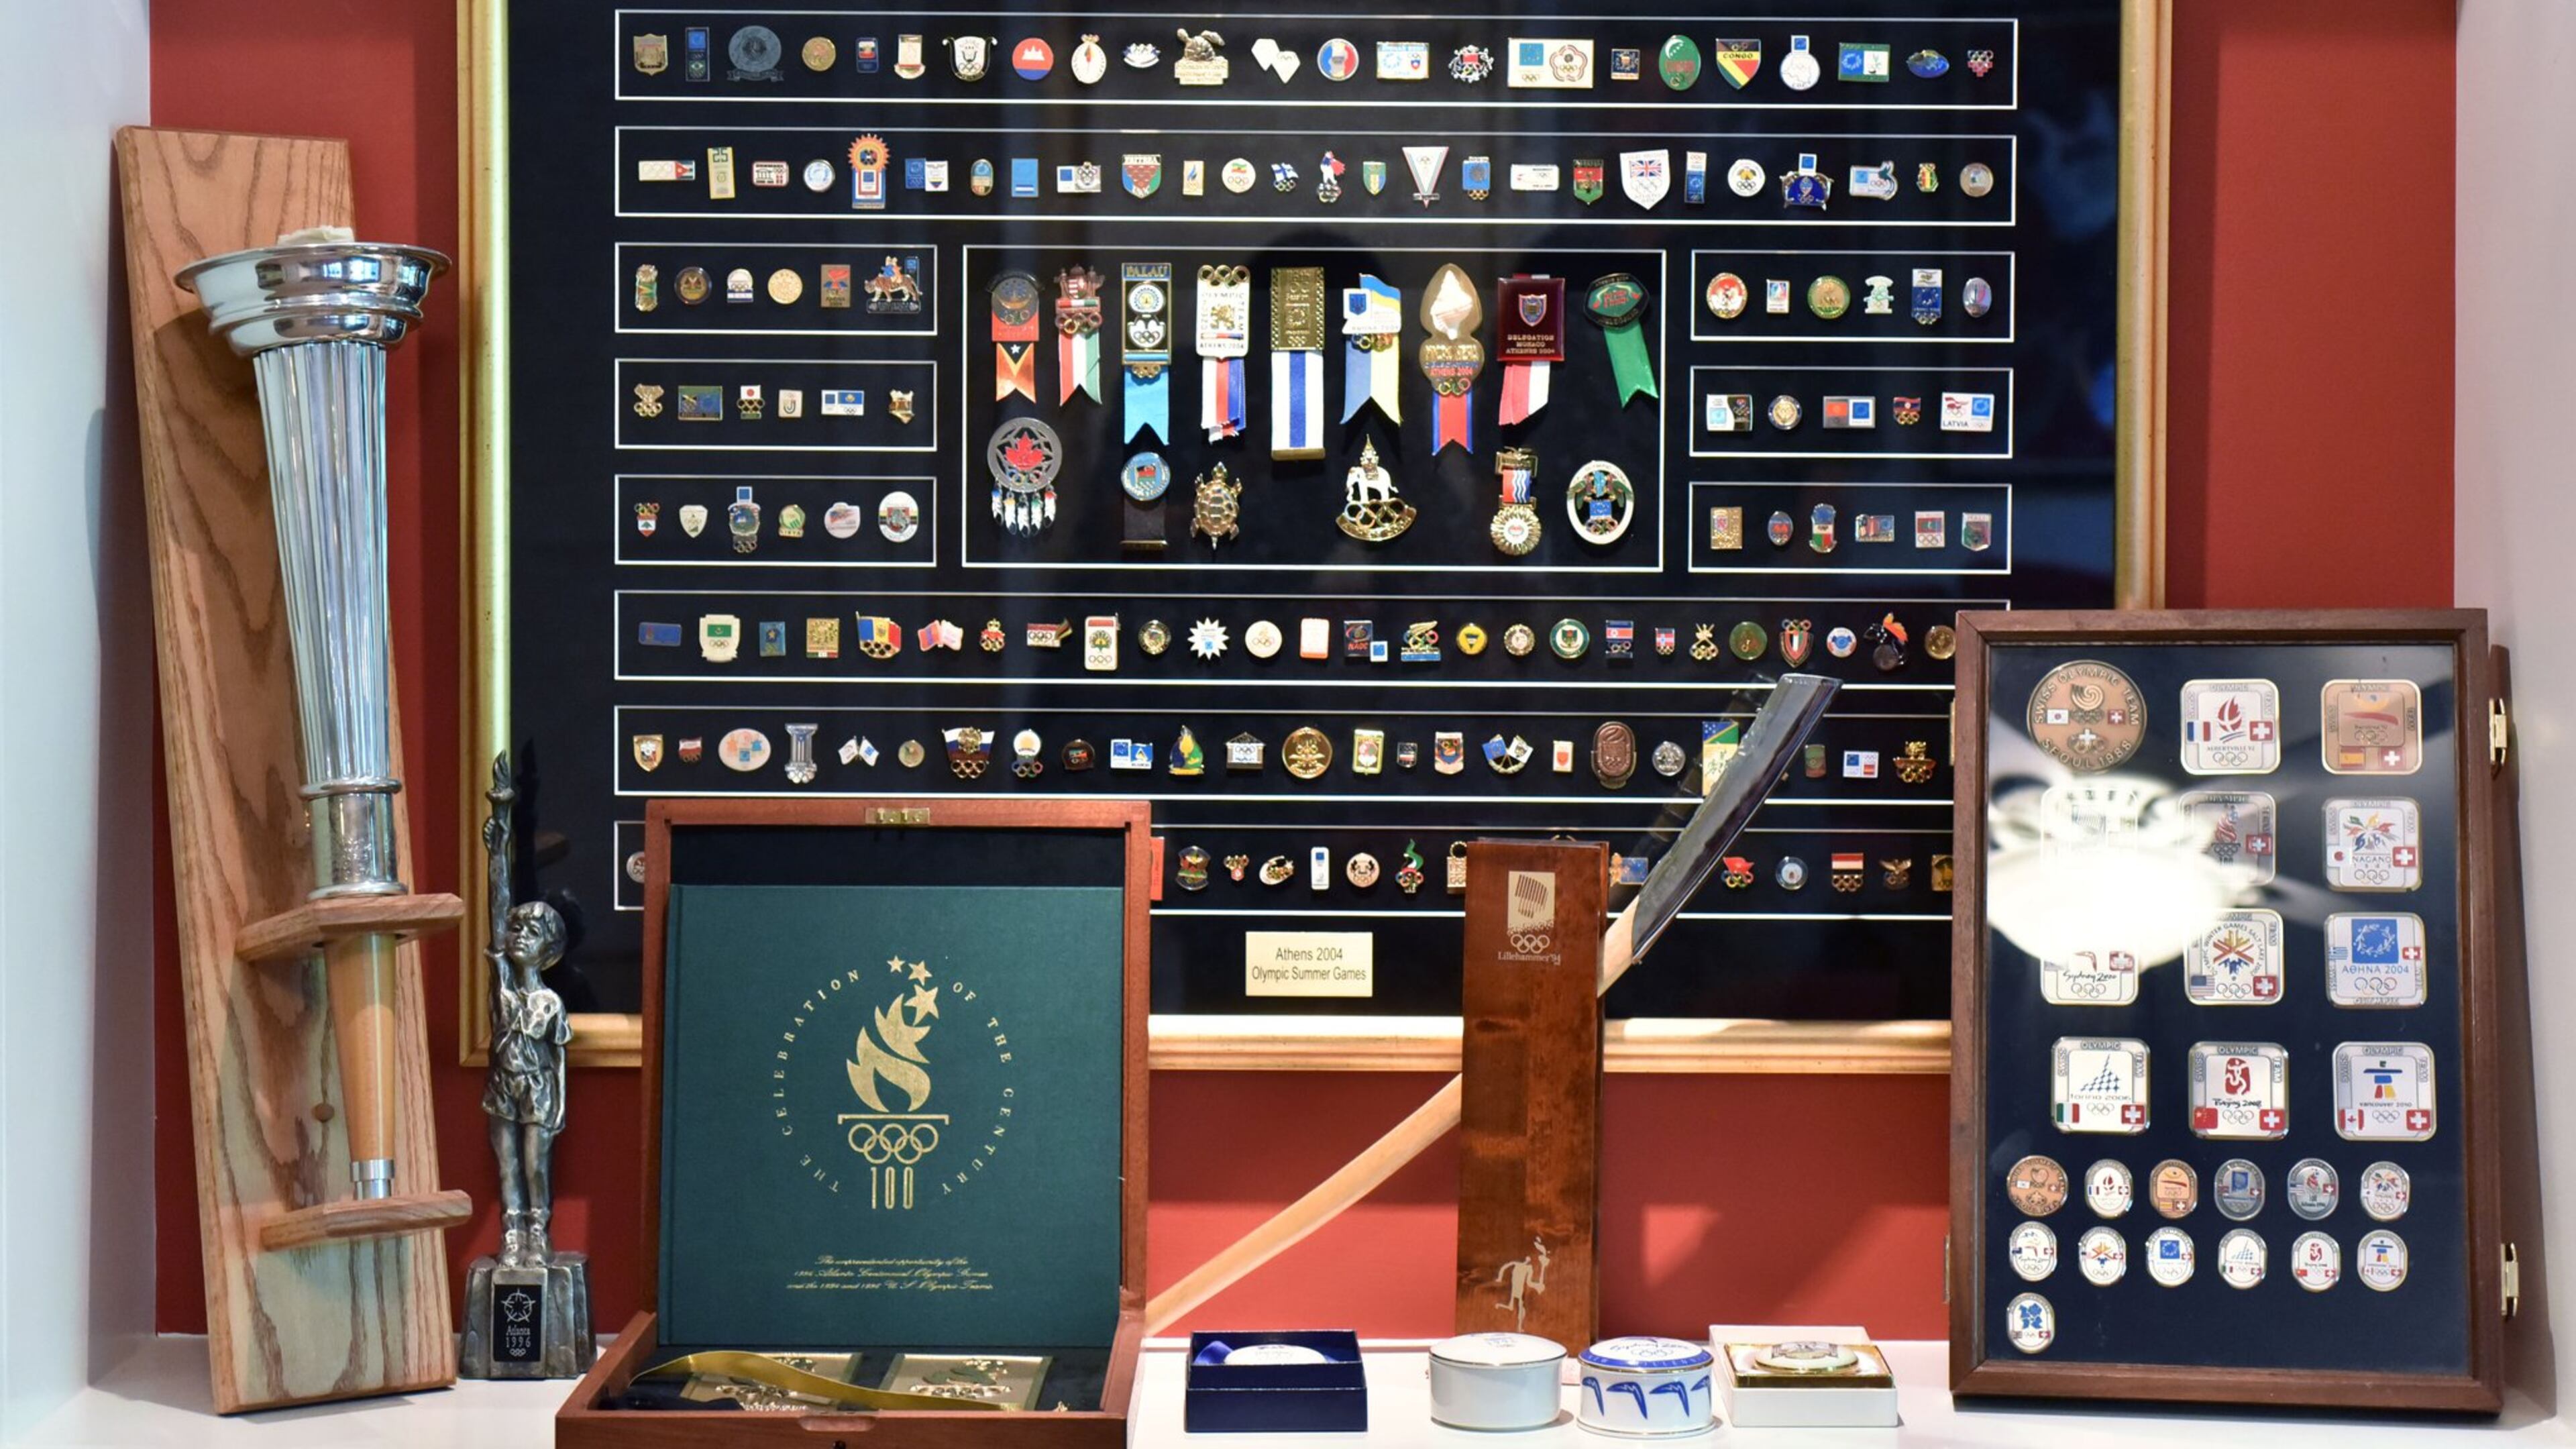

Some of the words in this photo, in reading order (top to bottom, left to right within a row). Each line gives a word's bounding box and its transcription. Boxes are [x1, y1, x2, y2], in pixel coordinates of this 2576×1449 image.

[1127, 265, 1168, 277] PALAU
[2035, 683, 2057, 724] SWISS
[2057, 666, 2120, 686] OLYMPIC
[2123, 688, 2140, 726] TEAM
[2042, 738, 2092, 768] SEOUL
[2098, 739, 2133, 767] 1988
[2223, 922, 2247, 931] GAMES
[1275, 947, 1313, 961] Athens
[1317, 947, 1343, 961] 2004
[1252, 965, 1289, 983] Olympic
[1291, 965, 1330, 980] Summer
[1333, 966, 1366, 980] Games
[2385, 965, 2410, 974] 2004
[953, 981, 977, 1002] OF
[987, 1017, 1012, 1063] THE
[2081, 1040, 2121, 1050] OLYMPIC
[773, 969, 860, 1136] CELEBRATION
[2218, 1046, 2259, 1055] OLYMPIC
[2363, 1046, 2404, 1056] OLYMPIC
[2272, 1057, 2282, 1083] TEAM
[942, 1087, 1015, 1195] CENTURY
[799, 1154, 841, 1193] THE
[869, 1166, 914, 1210] 100
[506, 1336, 531, 1348] 1996
